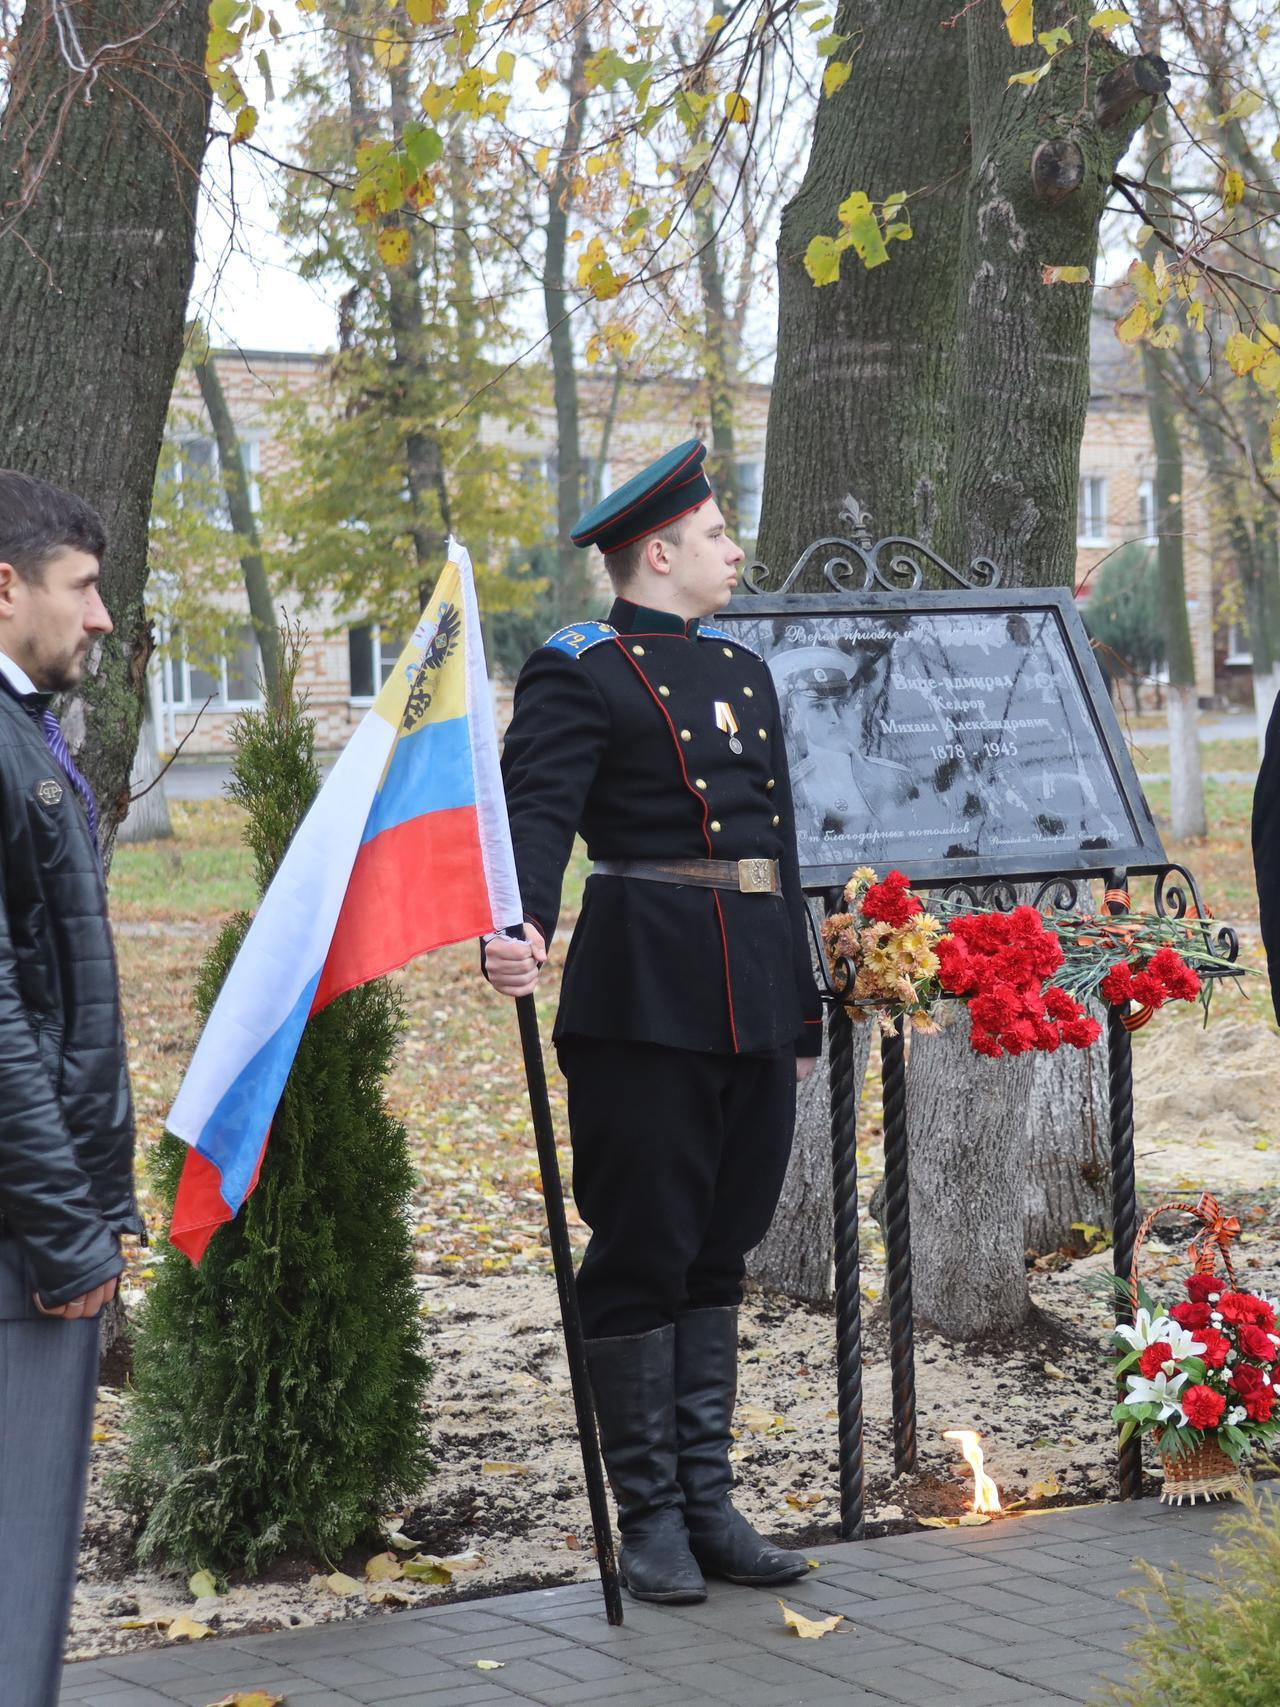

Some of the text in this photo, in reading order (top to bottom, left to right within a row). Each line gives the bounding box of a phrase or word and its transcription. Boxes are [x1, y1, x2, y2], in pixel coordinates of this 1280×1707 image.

[891, 673, 1014, 692] Вице-адмирал
[930, 695, 986, 712] Кедров
[879, 717, 1051, 734] Михаил Александрович
[930, 744, 966, 760] 1878
[983, 742, 1018, 758] 1945
[823, 830, 905, 846] благодарных
[908, 821, 971, 837] потомков
